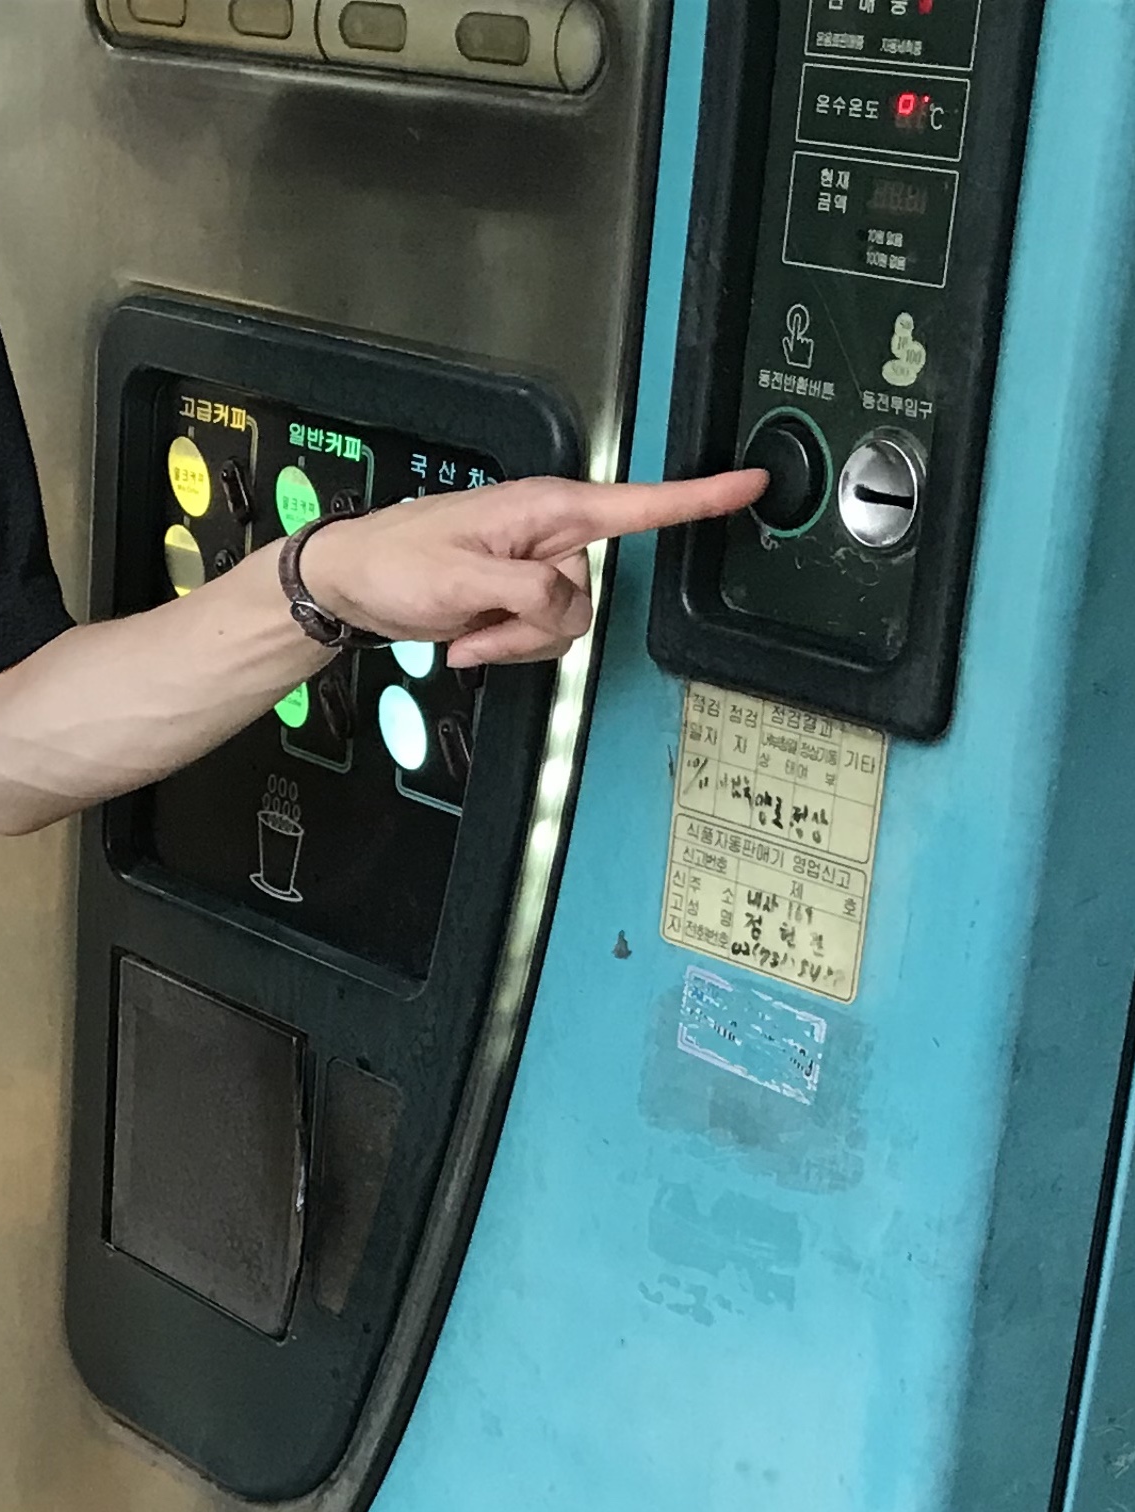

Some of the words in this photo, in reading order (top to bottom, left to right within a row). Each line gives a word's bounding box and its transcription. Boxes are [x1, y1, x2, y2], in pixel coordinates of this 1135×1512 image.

[816, 94, 880, 120] 온수온도
[820, 167, 851, 190] 현재
[817, 192, 848, 214] 금액
[758, 368, 836, 401] 동전반환버튼
[179, 395, 247, 432] 고급커피
[862, 390, 933, 420] 동전투입구
[288, 422, 363, 463] 일반커피
[771, 705, 834, 739] 점검결과
[844, 750, 875, 775] 기타
[686, 822, 785, 868] 식품자동판매기
[792, 855, 851, 890] 영업신고
